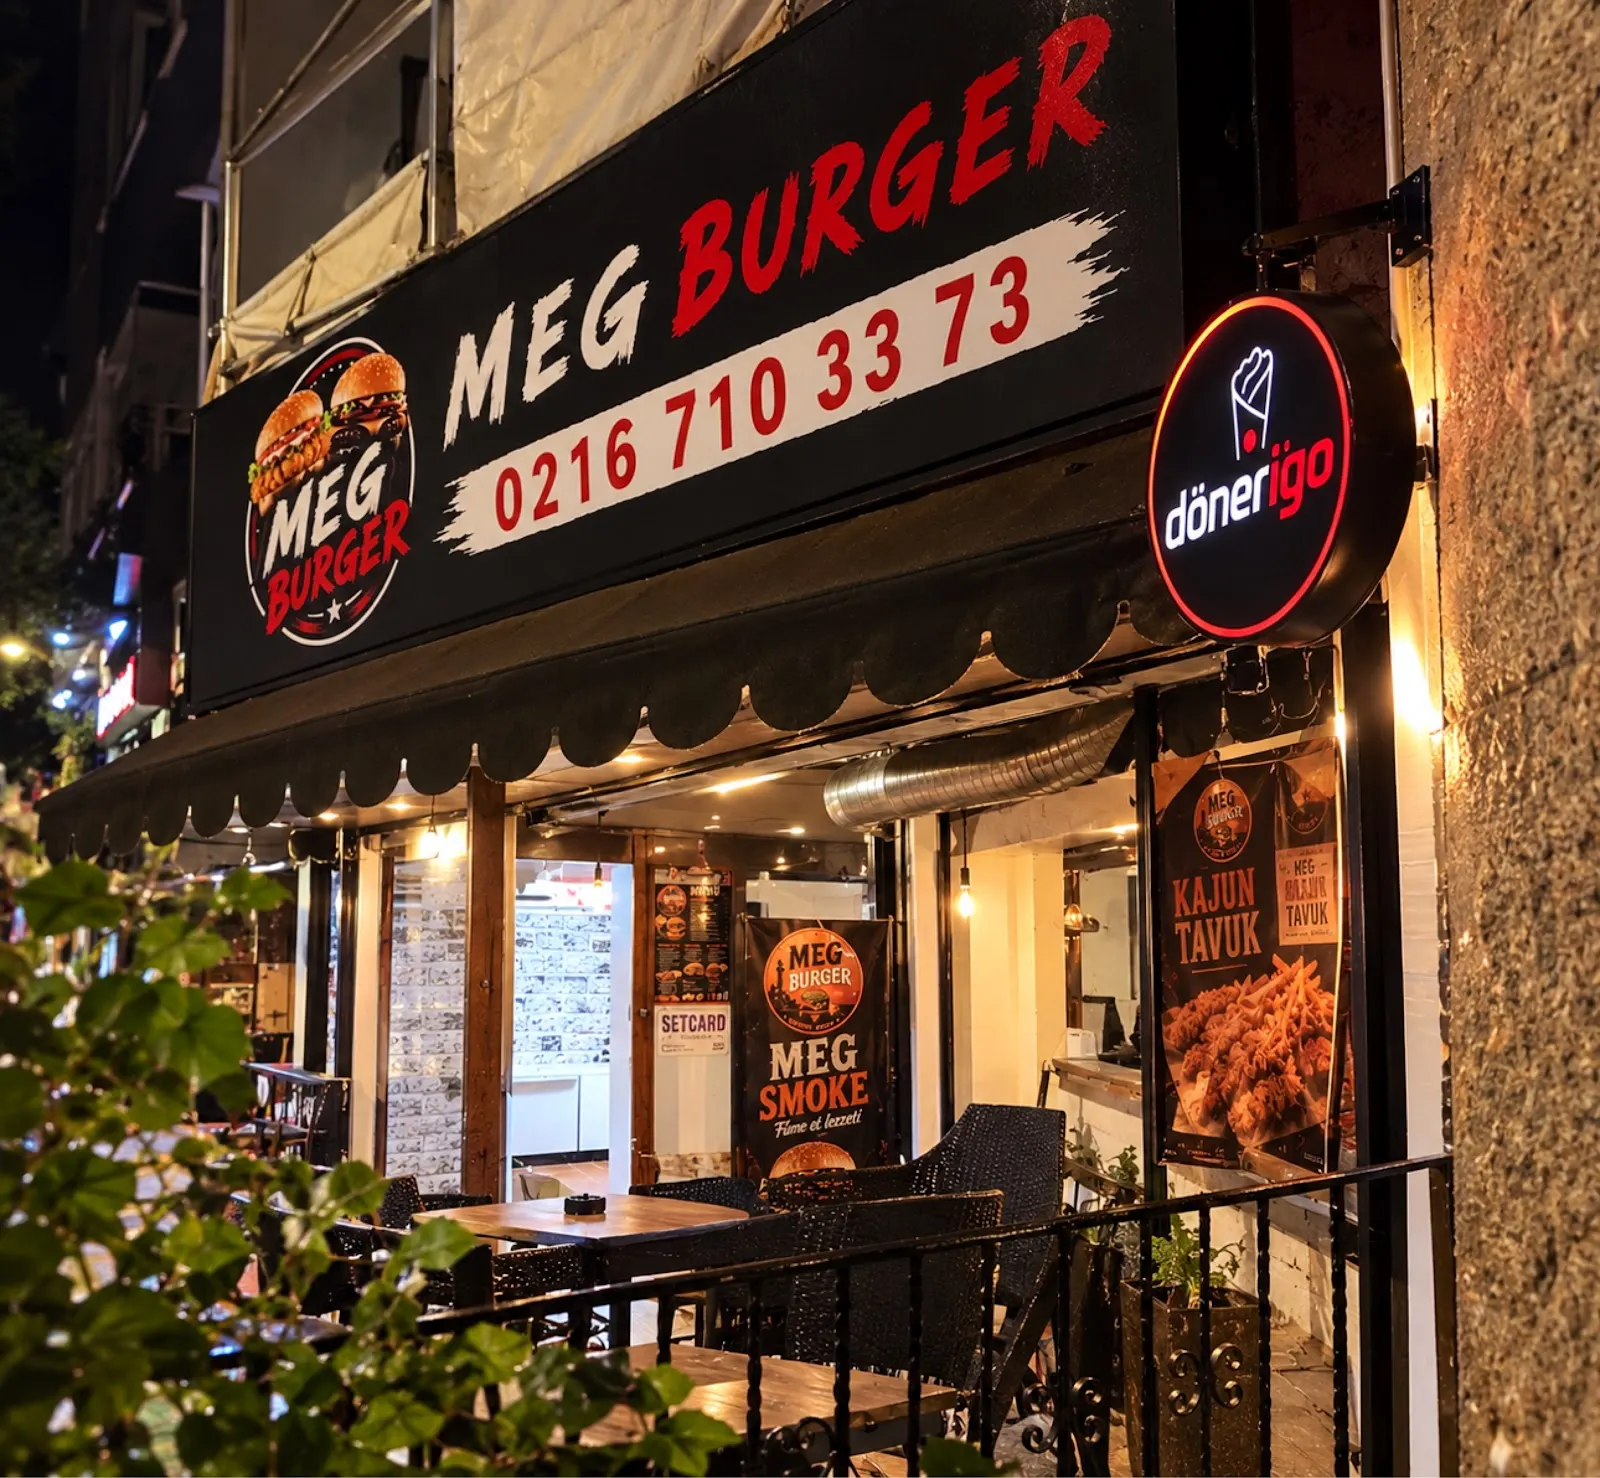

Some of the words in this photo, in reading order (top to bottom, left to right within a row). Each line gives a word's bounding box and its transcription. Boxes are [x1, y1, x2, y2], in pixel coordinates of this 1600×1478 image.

[443, 243, 648, 452] MEG
[671, 14, 1112, 338] BURGER
[495, 418, 637, 533] 0216
[665, 356, 787, 471] 710
[816, 308, 901, 411] 33
[934, 255, 1031, 368] 73
[263, 440, 388, 579] MEG
[265, 499, 411, 635] BURGER
[1208, 789, 1235, 812] MEG
[1294, 858, 1315, 876] MEG
[1172, 868, 1255, 918] KAJUN
[1286, 901, 1328, 927] TAVUK
[789, 941, 843, 970] MEG
[1175, 911, 1262, 964] TAVUK
[789, 967, 852, 993] BURGER
[662, 1014, 726, 1033] SETCARD
[769, 1033, 858, 1082] MEG
[759, 1070, 869, 1121] SMOKE
[809, 1116, 823, 1132] et
